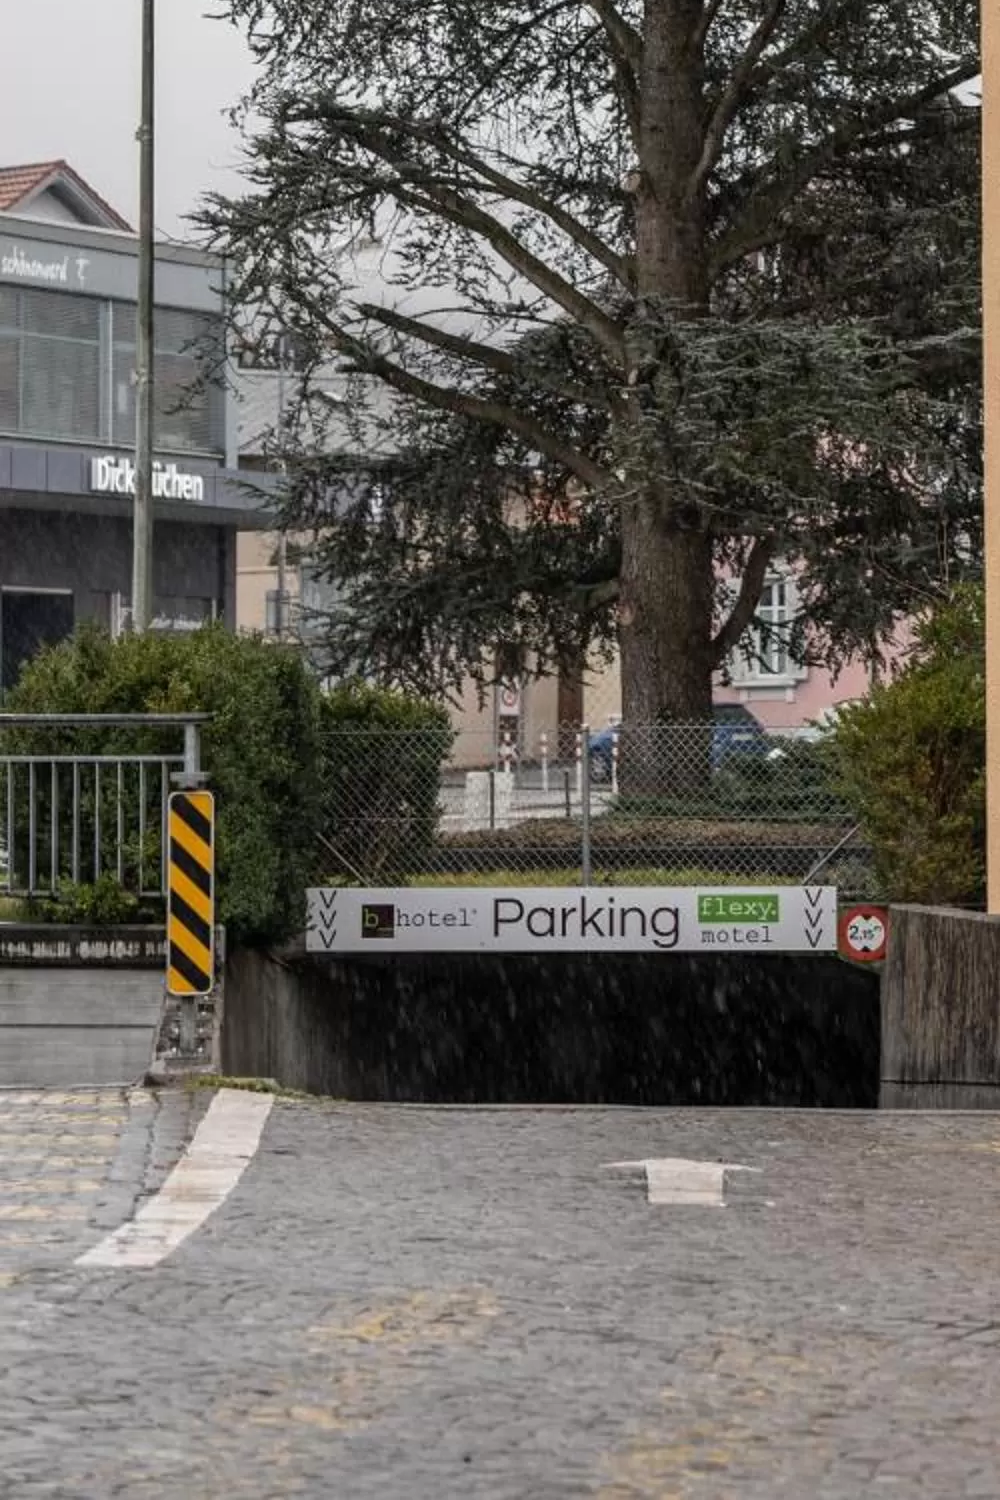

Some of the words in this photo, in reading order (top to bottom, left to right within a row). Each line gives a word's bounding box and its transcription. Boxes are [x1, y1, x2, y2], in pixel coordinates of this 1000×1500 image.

[149, 461, 204, 501] üchen
[396, 907, 472, 927] hotel
[493, 896, 679, 948] Parking
[701, 926, 773, 943] motel
